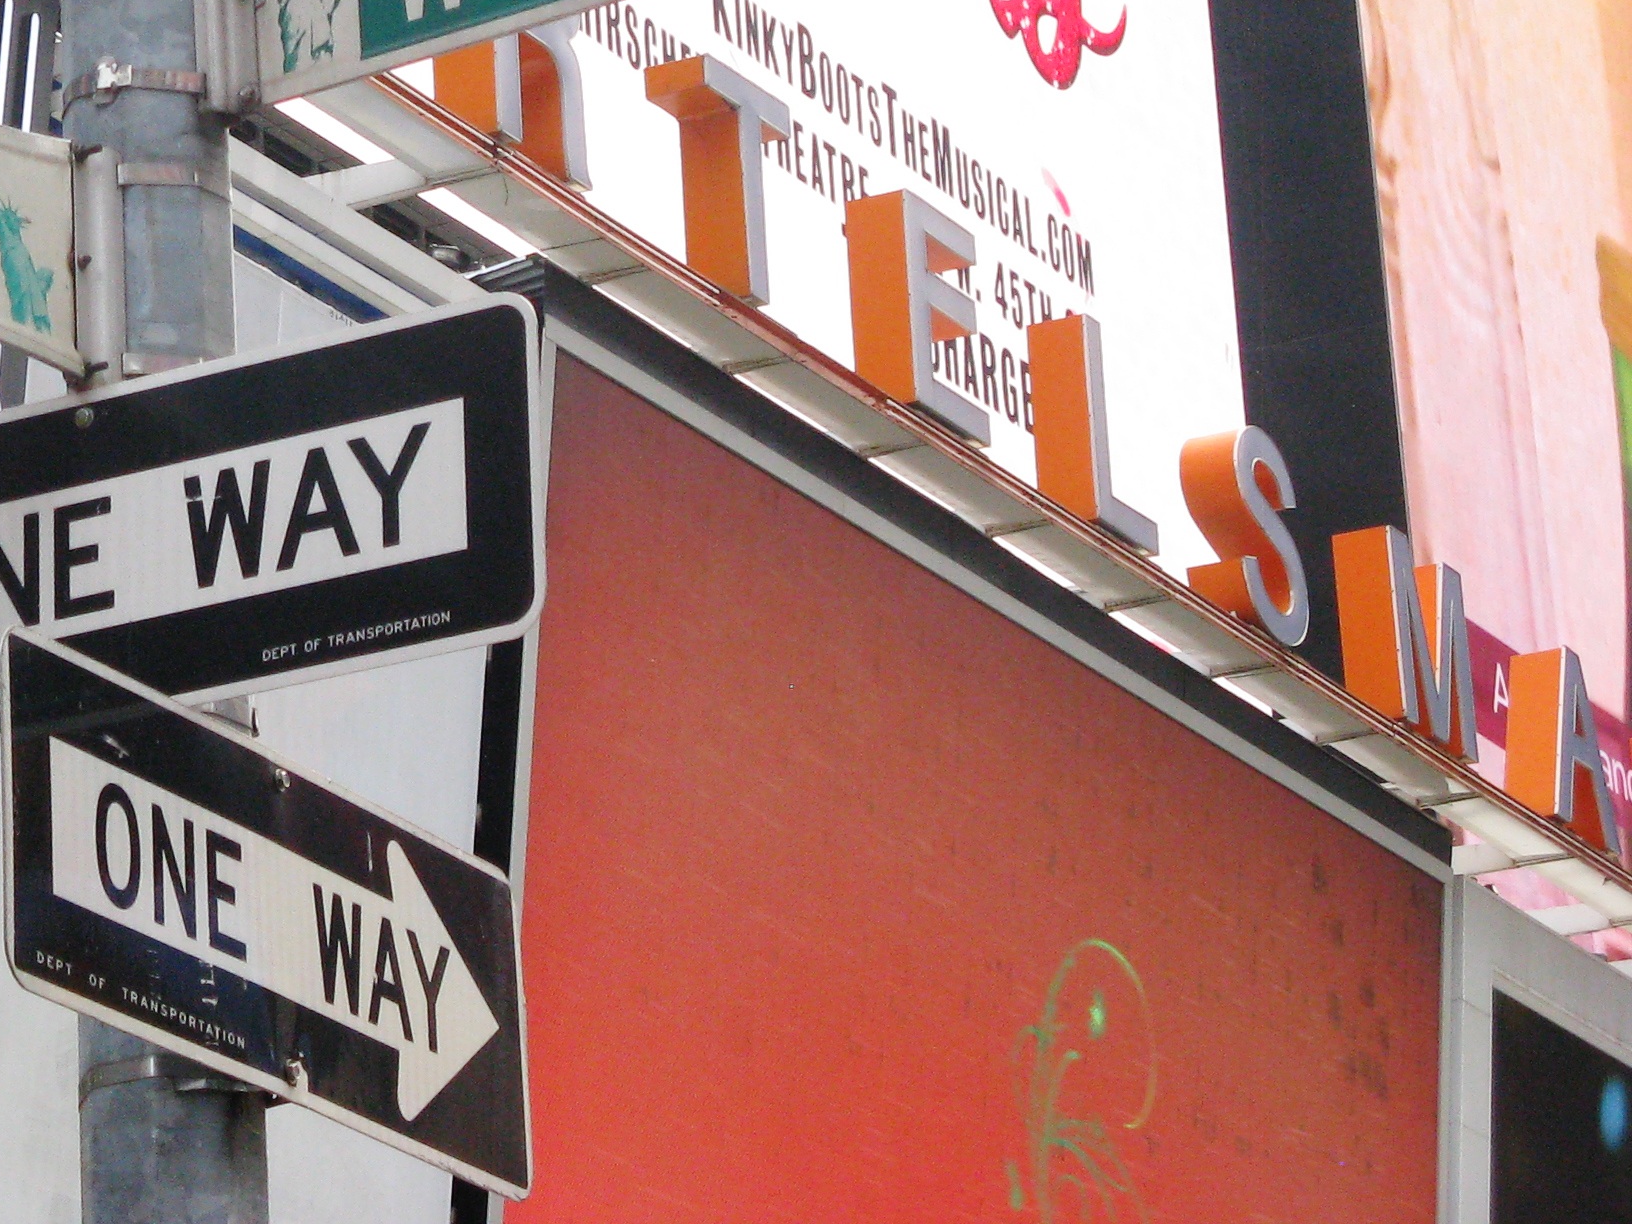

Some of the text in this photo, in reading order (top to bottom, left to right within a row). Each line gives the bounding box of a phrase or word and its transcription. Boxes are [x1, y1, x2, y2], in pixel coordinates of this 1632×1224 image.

[183, 421, 432, 589] WAY
[262, 610, 452, 662] DEPT OF TRANSPORTATION
[95, 782, 451, 1054] ONE WAY
[35, 950, 247, 1050] DEPT OF TRANSPORTATION
